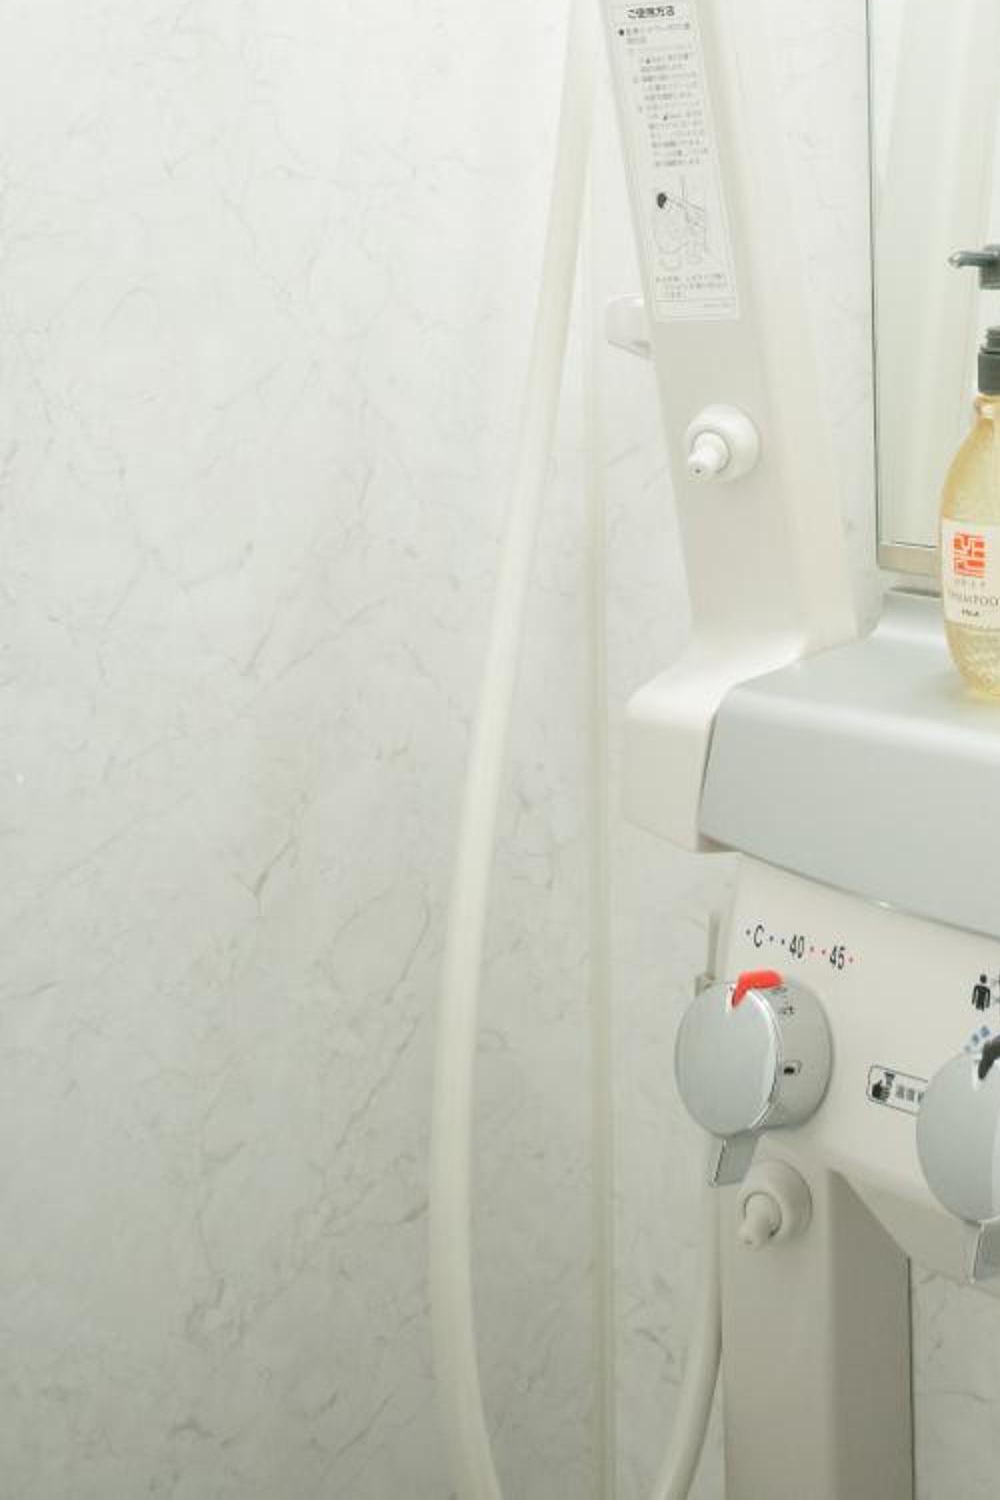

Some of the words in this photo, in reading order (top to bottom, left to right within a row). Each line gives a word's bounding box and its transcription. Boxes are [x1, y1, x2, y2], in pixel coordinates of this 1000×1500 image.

[626, 4, 676, 20] ご使用方法
[789, 934, 805, 960] 40
[829, 945, 846, 971] 45
